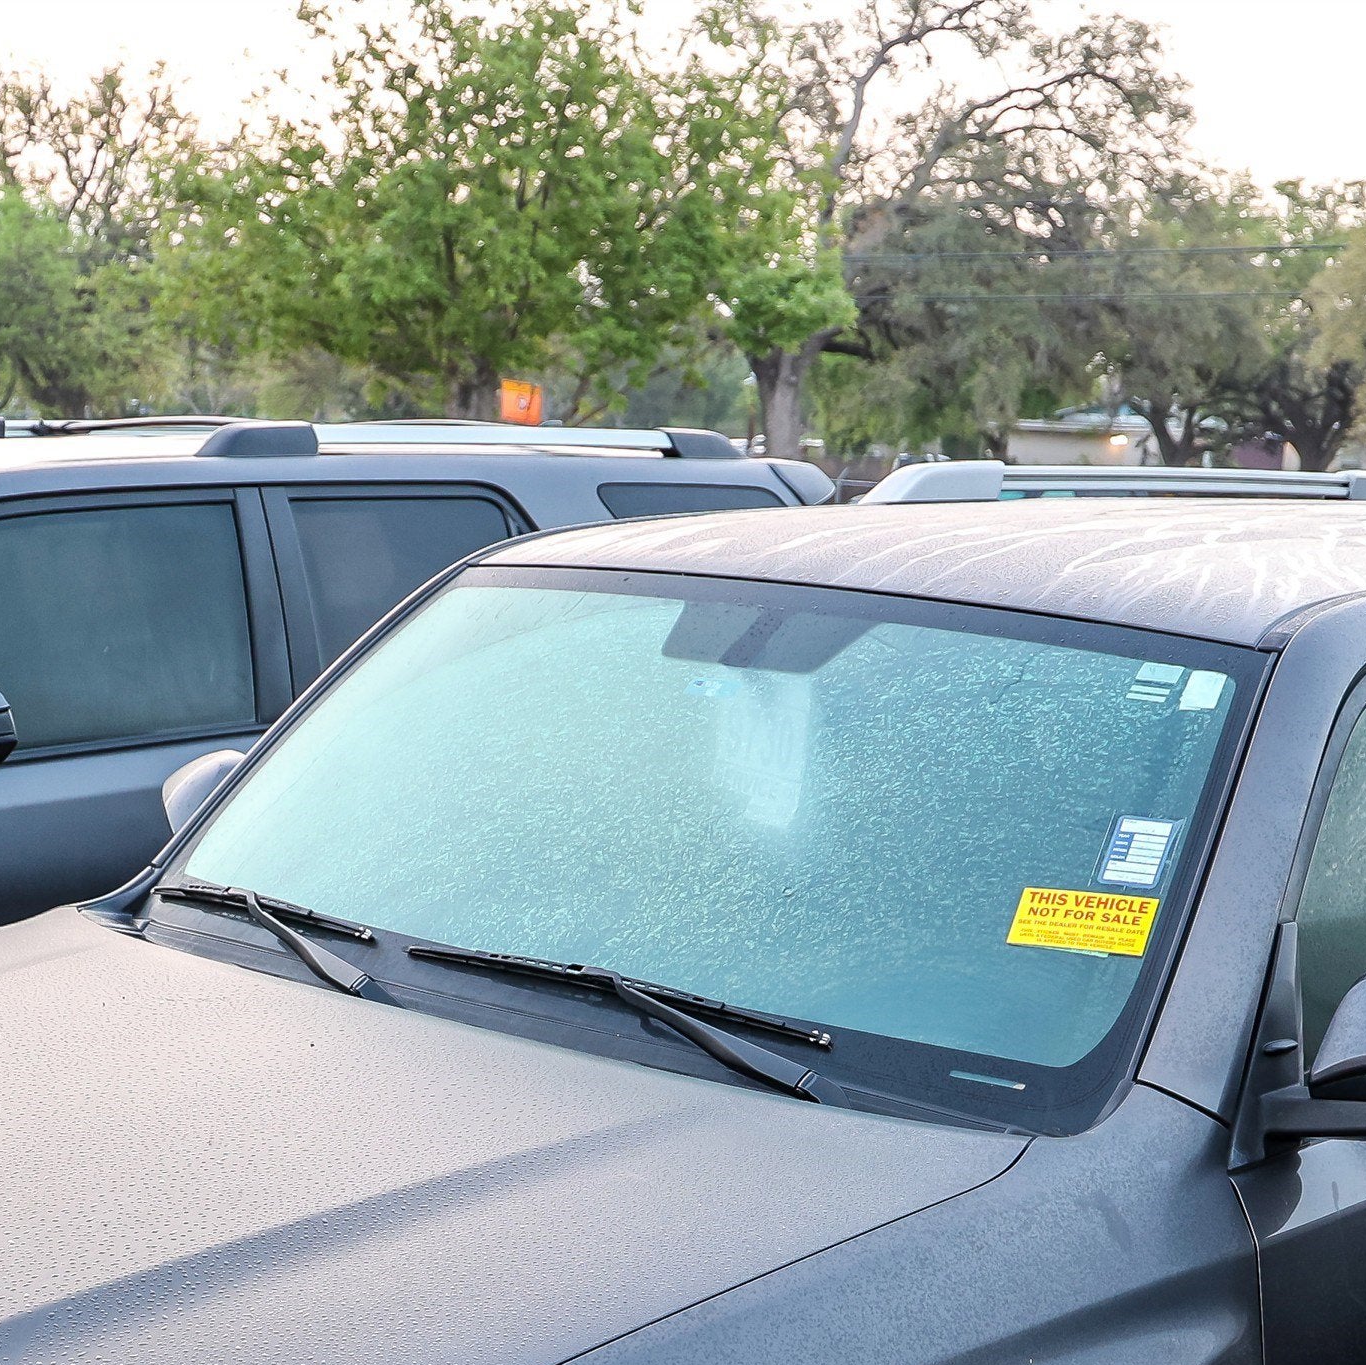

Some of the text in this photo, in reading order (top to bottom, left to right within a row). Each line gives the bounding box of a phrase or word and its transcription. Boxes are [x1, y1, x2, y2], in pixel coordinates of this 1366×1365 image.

[1029, 891, 1151, 914] THIS VEHICLE
[1028, 907, 1142, 926] NOT FOR SALE
[1096, 925, 1124, 933] RESALE
[1126, 928, 1146, 936] DATE
